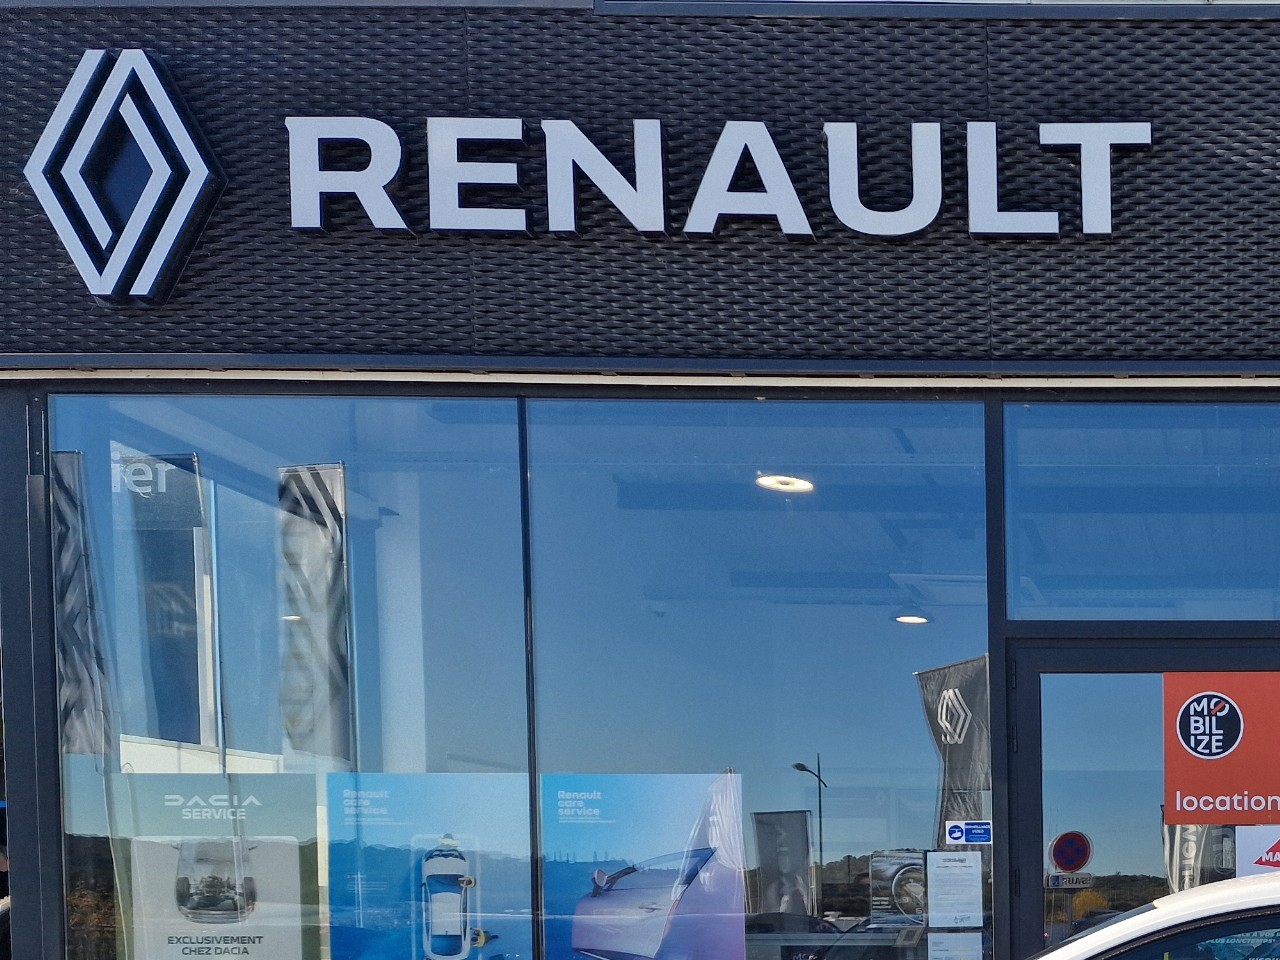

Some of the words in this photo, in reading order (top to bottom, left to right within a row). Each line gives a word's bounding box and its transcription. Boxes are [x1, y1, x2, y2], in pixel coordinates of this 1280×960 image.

[284, 116, 1153, 236] RENAULT
[557, 790, 602, 799] Renault
[164, 794, 263, 807] DACIA
[557, 799, 584, 808] care
[182, 808, 247, 820] SERVICE
[557, 807, 600, 816] service
[168, 936, 263, 945] EXCLUSIVEMENT
[182, 947, 212, 955] CHEZ
[214, 947, 249, 955] DACIA
